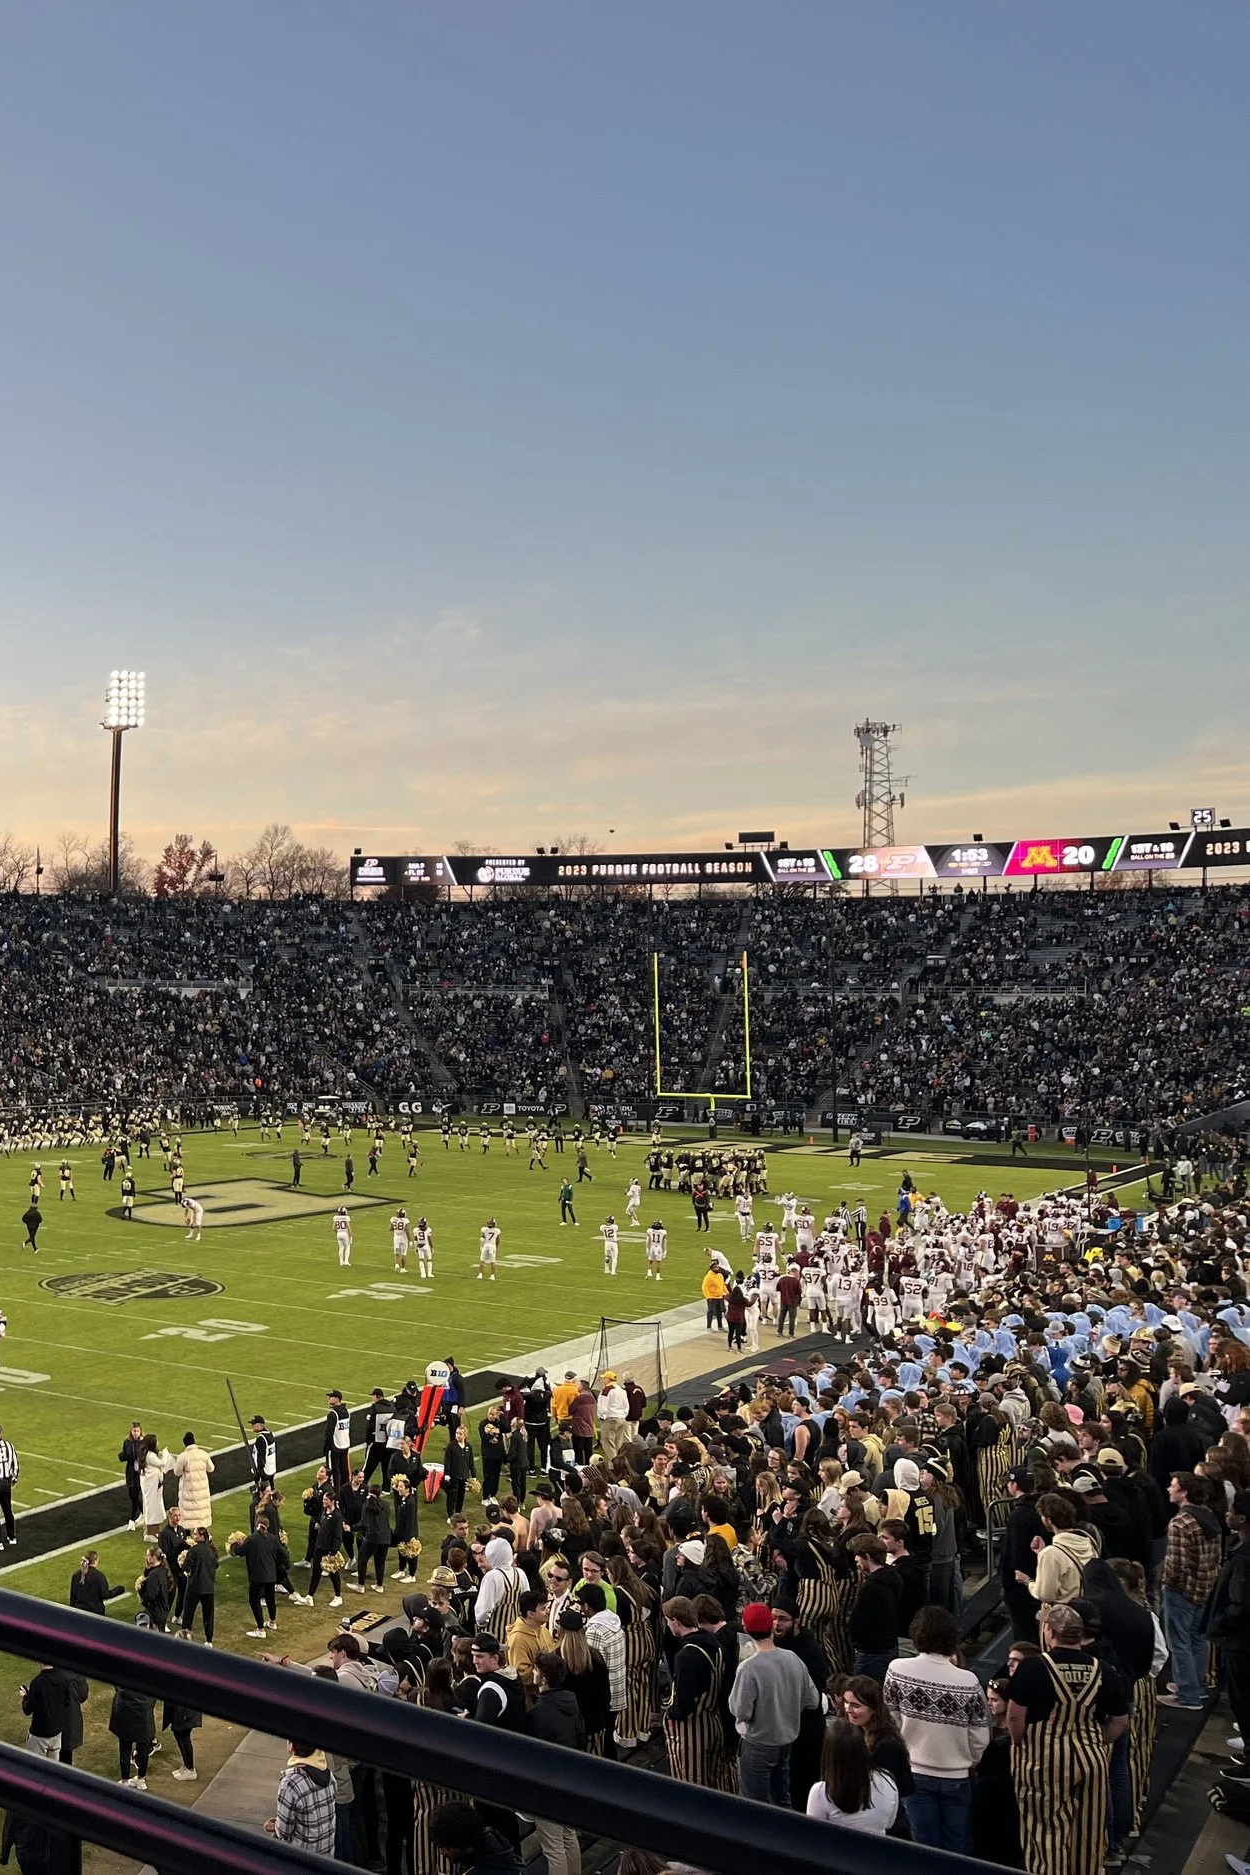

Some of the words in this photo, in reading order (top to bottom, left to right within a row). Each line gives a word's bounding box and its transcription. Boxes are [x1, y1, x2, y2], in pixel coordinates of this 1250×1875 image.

[1193, 810, 1212, 823] 25
[1205, 841, 1240, 855] 2023
[951, 848, 988, 861] 1:53
[1021, 846, 1058, 868] M
[1062, 845, 1095, 865] 20
[558, 865, 587, 876] 2023
[592, 863, 637, 875] PURDUE
[642, 863, 700, 875] FOOTBALL
[705, 862, 752, 873] SEASON
[848, 855, 879, 873] 28
[495, 867, 530, 876] PURDUE
[481, 1103, 501, 1114] P
[898, 1116, 921, 1128] P
[1091, 1129, 1114, 1143] P
[335, 1220, 347, 1230] 80
[417, 1231, 425, 1241] 9
[487, 1231, 495, 1241] 7
[603, 1229, 614, 1238] 12
[651, 1233, 661, 1243] 11
[759, 1236, 773, 1246] 65
[831, 1256, 842, 1264] 17
[759, 1270, 774, 1281] 33
[838, 1279, 850, 1291] 13
[904, 1284, 923, 1295] 52
[158, 1317, 271, 1342] 20
[914, 1505, 934, 1536] 15
